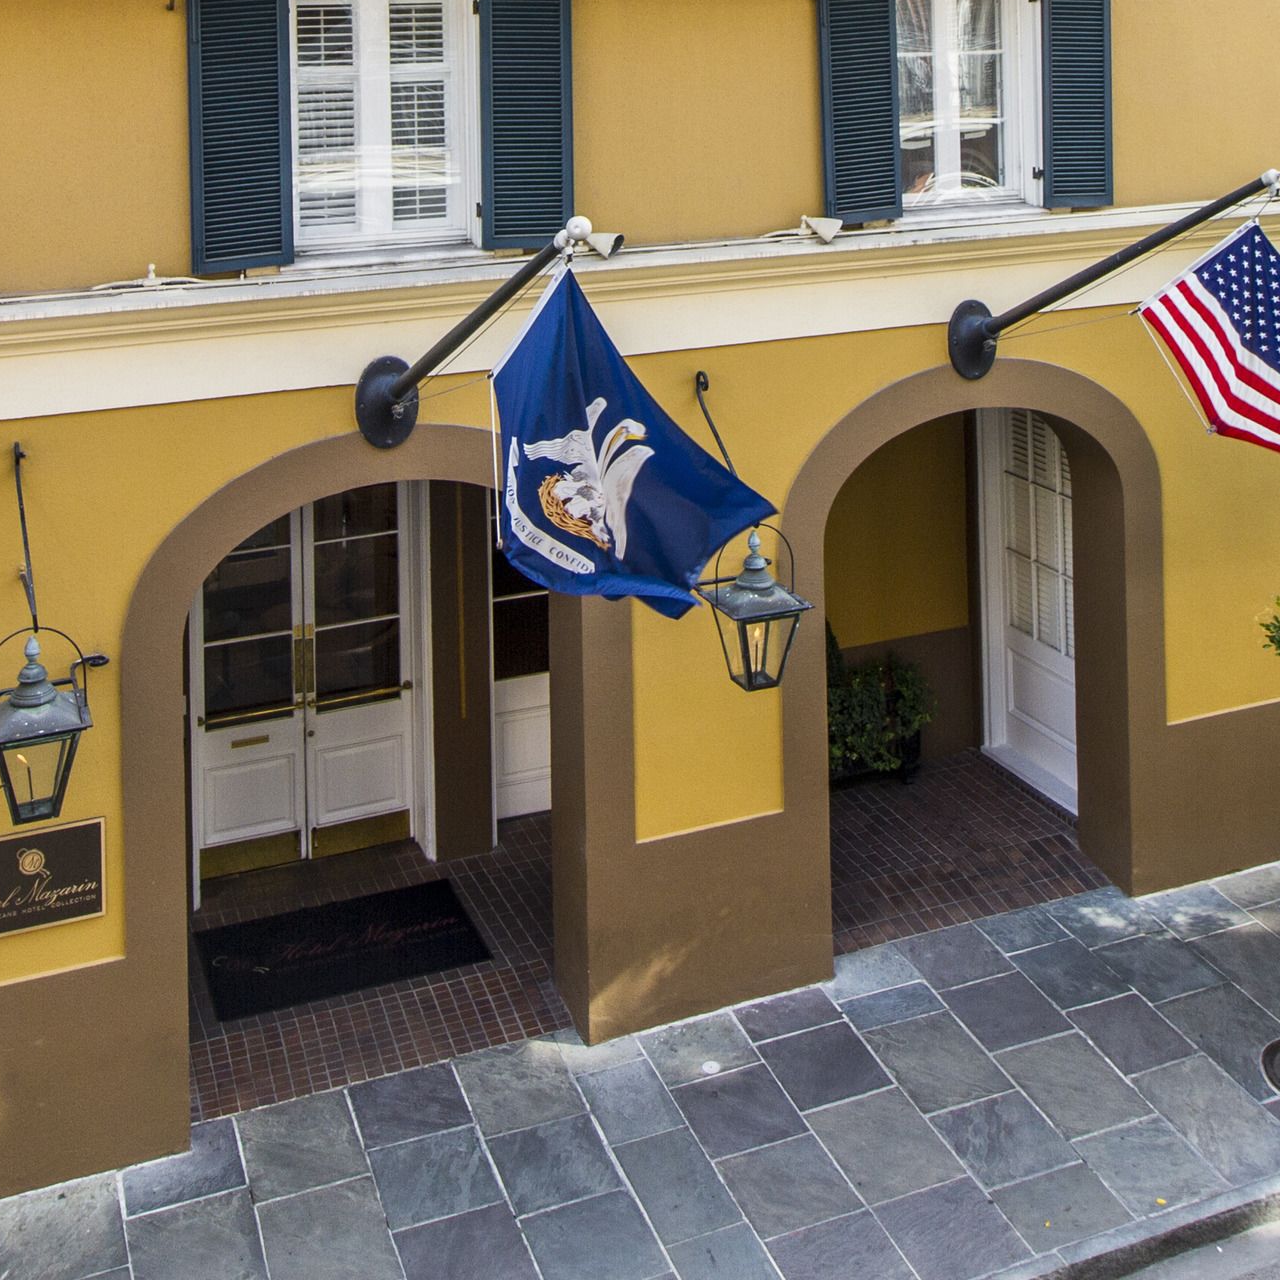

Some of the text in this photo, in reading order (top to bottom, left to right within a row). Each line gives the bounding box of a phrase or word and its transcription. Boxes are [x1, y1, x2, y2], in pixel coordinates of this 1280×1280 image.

[513, 517, 544, 545] JUSTICE
[15, 876, 98, 906] Mazarin
[22, 904, 46, 915] HOTEL
[50, 894, 97, 909] COLLECTION
